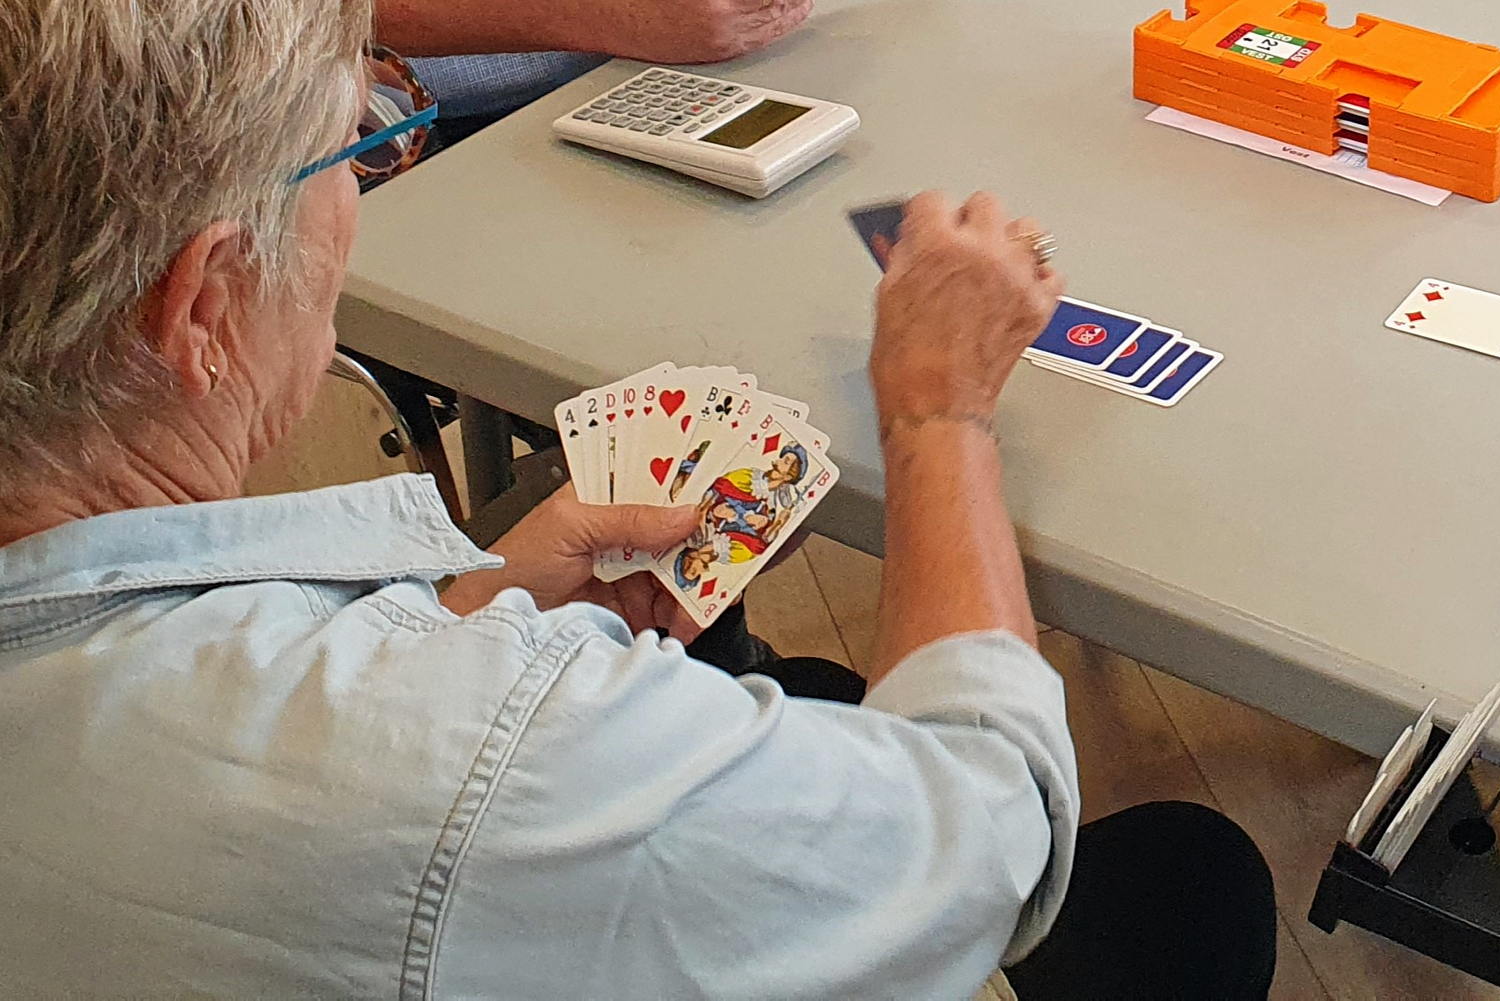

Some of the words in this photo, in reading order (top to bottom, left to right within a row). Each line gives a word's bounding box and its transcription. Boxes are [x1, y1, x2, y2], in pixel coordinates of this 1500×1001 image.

[1257, 39, 1278, 51] 21
[1241, 48, 1275, 60] VEST
[1291, 48, 1313, 62] SYD
[1282, 147, 1310, 158] Vest
[606, 393, 616, 408] D
[623, 388, 636, 404] 10
[644, 385, 655, 401] 8
[707, 386, 719, 402] B
[587, 398, 597, 414] 2
[565, 409, 576, 423] 4
[760, 414, 773, 429] B
[817, 471, 830, 486] B
[704, 603, 717, 618] B
